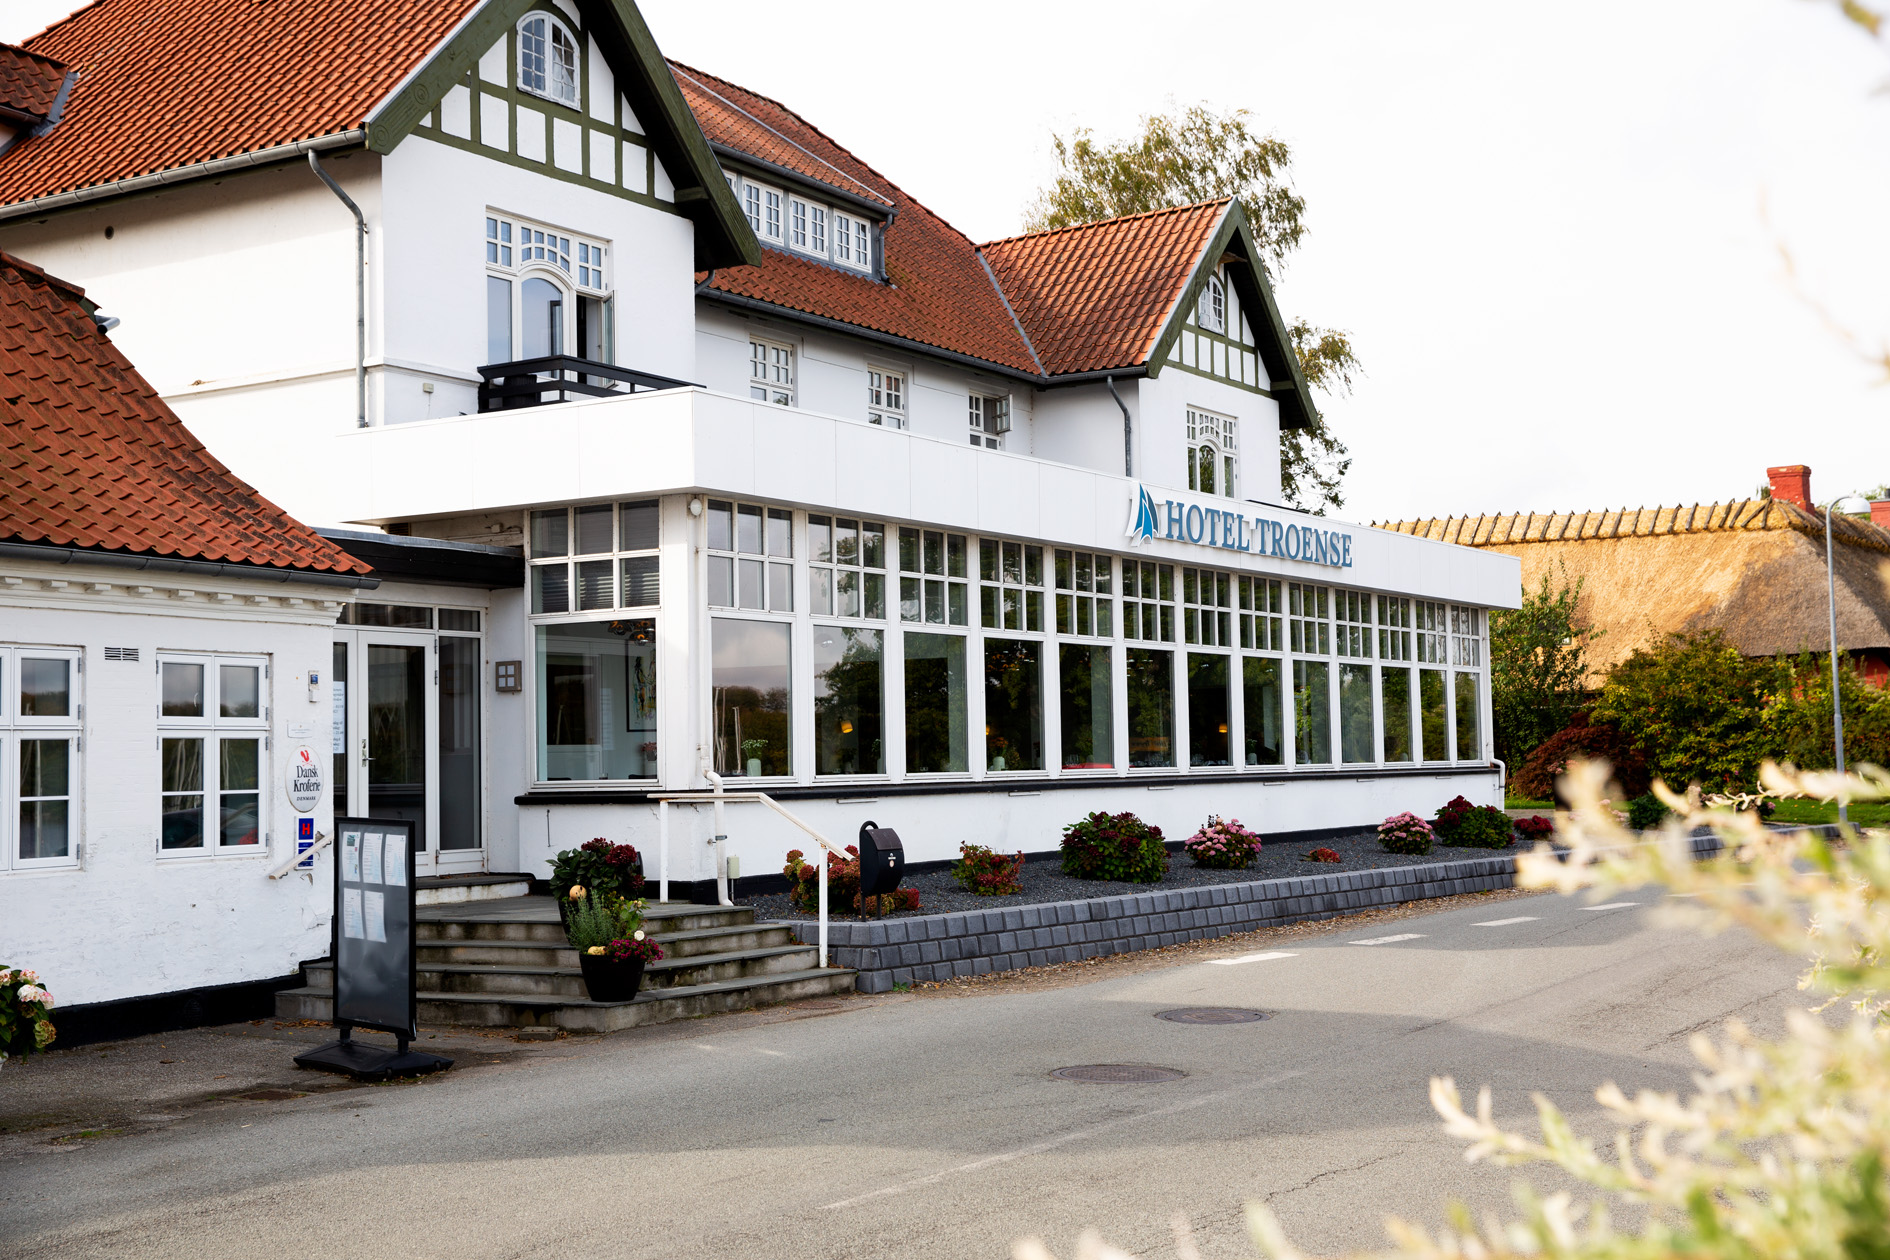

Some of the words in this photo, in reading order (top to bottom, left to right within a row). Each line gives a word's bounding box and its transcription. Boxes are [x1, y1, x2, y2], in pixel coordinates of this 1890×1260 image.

[1166, 500, 1250, 551] HOTEL
[1255, 518, 1353, 568] TROENSE
[296, 765, 318, 778] Dansk
[293, 779, 321, 792] Kroferie
[302, 823, 310, 835] H
